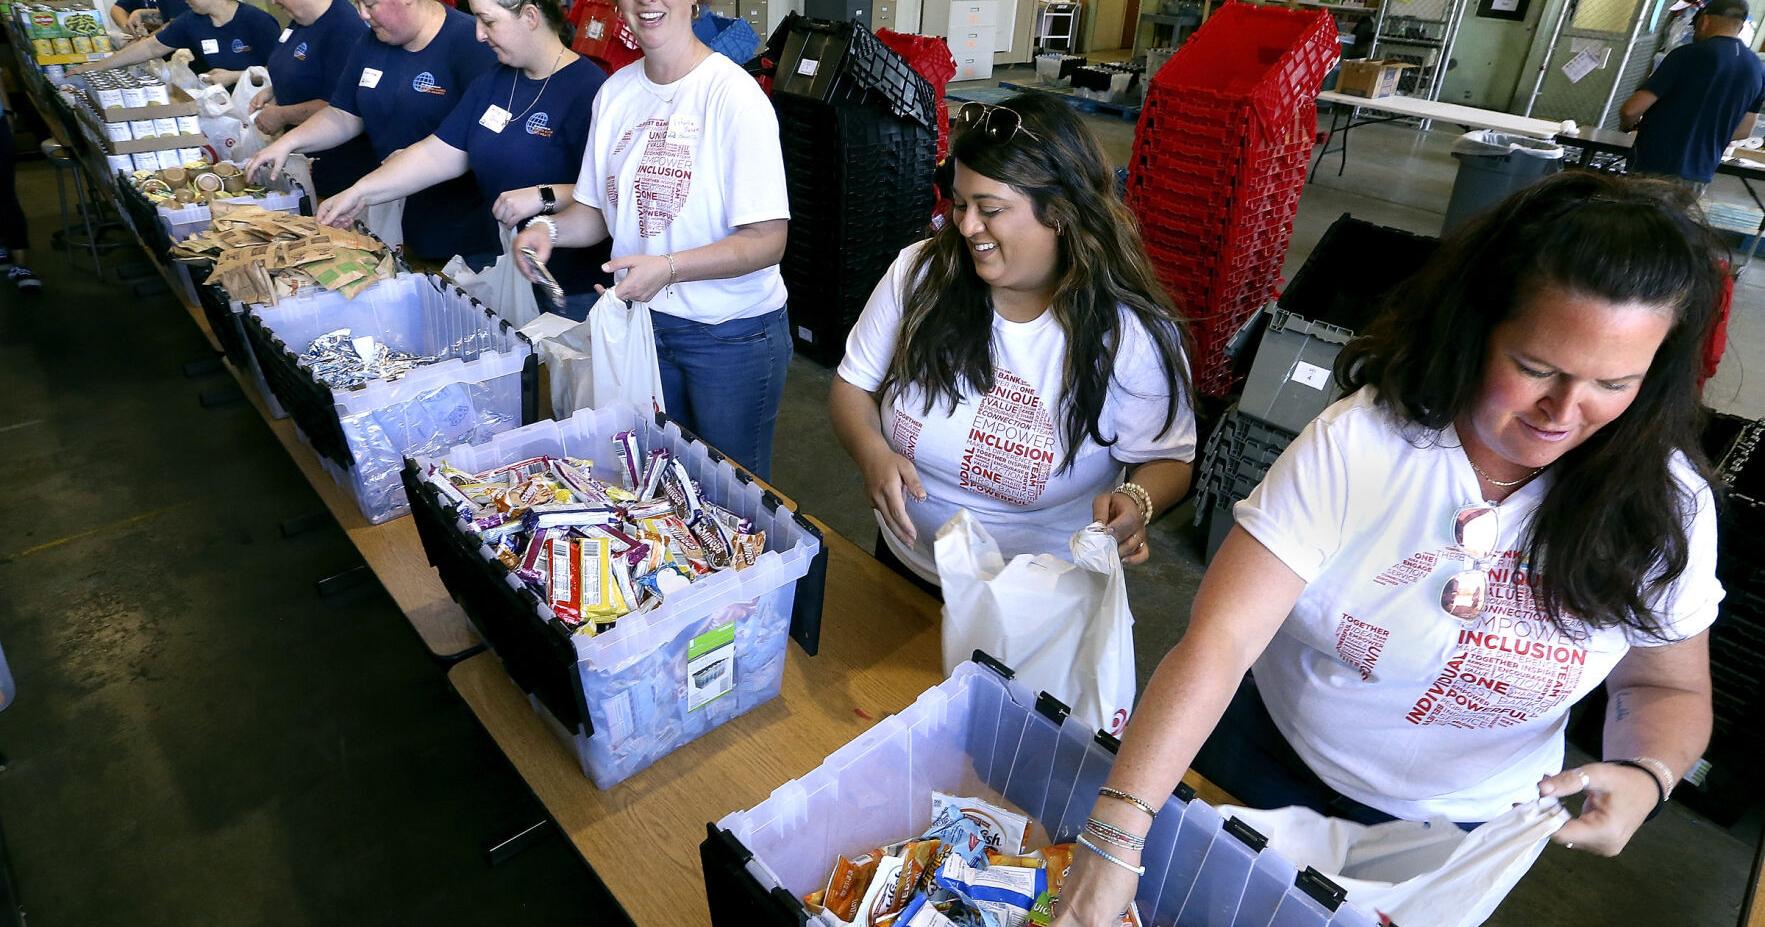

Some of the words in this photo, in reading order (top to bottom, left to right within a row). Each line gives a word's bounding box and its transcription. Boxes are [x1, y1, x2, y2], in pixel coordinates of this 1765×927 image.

[637, 165, 692, 180] INCLUSION
[641, 190, 658, 200] ONE
[634, 178, 645, 238] INDIVIDUAL
[998, 372, 1021, 384] BANK
[1020, 386, 1035, 395] ONE
[987, 398, 1018, 413] VALUE
[896, 409, 923, 429] TOGETHER
[981, 410, 1032, 430] CONNECTION
[972, 415, 1056, 450] EMPOWER
[966, 439, 984, 449] MAKE
[968, 428, 1054, 464] INCLUSION
[976, 448, 1007, 463] TOGETHER
[1007, 459, 1031, 471] INSPIRE
[993, 460, 1024, 474] ENCOURAGE
[971, 465, 1002, 485] ONE
[991, 466, 1023, 481] ACTION
[1029, 461, 1041, 487] TEAM
[1402, 559, 1433, 572] ENGAGE
[1414, 552, 1435, 563] ONE
[1387, 568, 1418, 583] SERVICE
[1391, 562, 1429, 578] ACTION
[1342, 612, 1390, 637] TOGETHER
[1477, 614, 1591, 646] MPOWER
[1349, 632, 1384, 648] EMPOWER
[1457, 629, 1588, 666] INCLUSION
[1464, 667, 1489, 677] VALUE
[1470, 653, 1519, 668] TOGETHER
[1521, 664, 1556, 677] INSPIRE
[1497, 666, 1548, 683] ENCOURAGE
[1405, 652, 1468, 725] INDIVIDUAL
[1459, 672, 1510, 695] ONE
[1493, 672, 1545, 693] ACTION
[1548, 664, 1570, 697] TEAM
[1446, 688, 1528, 721] POWERFUL
[1451, 684, 1490, 706] EMPOWER
